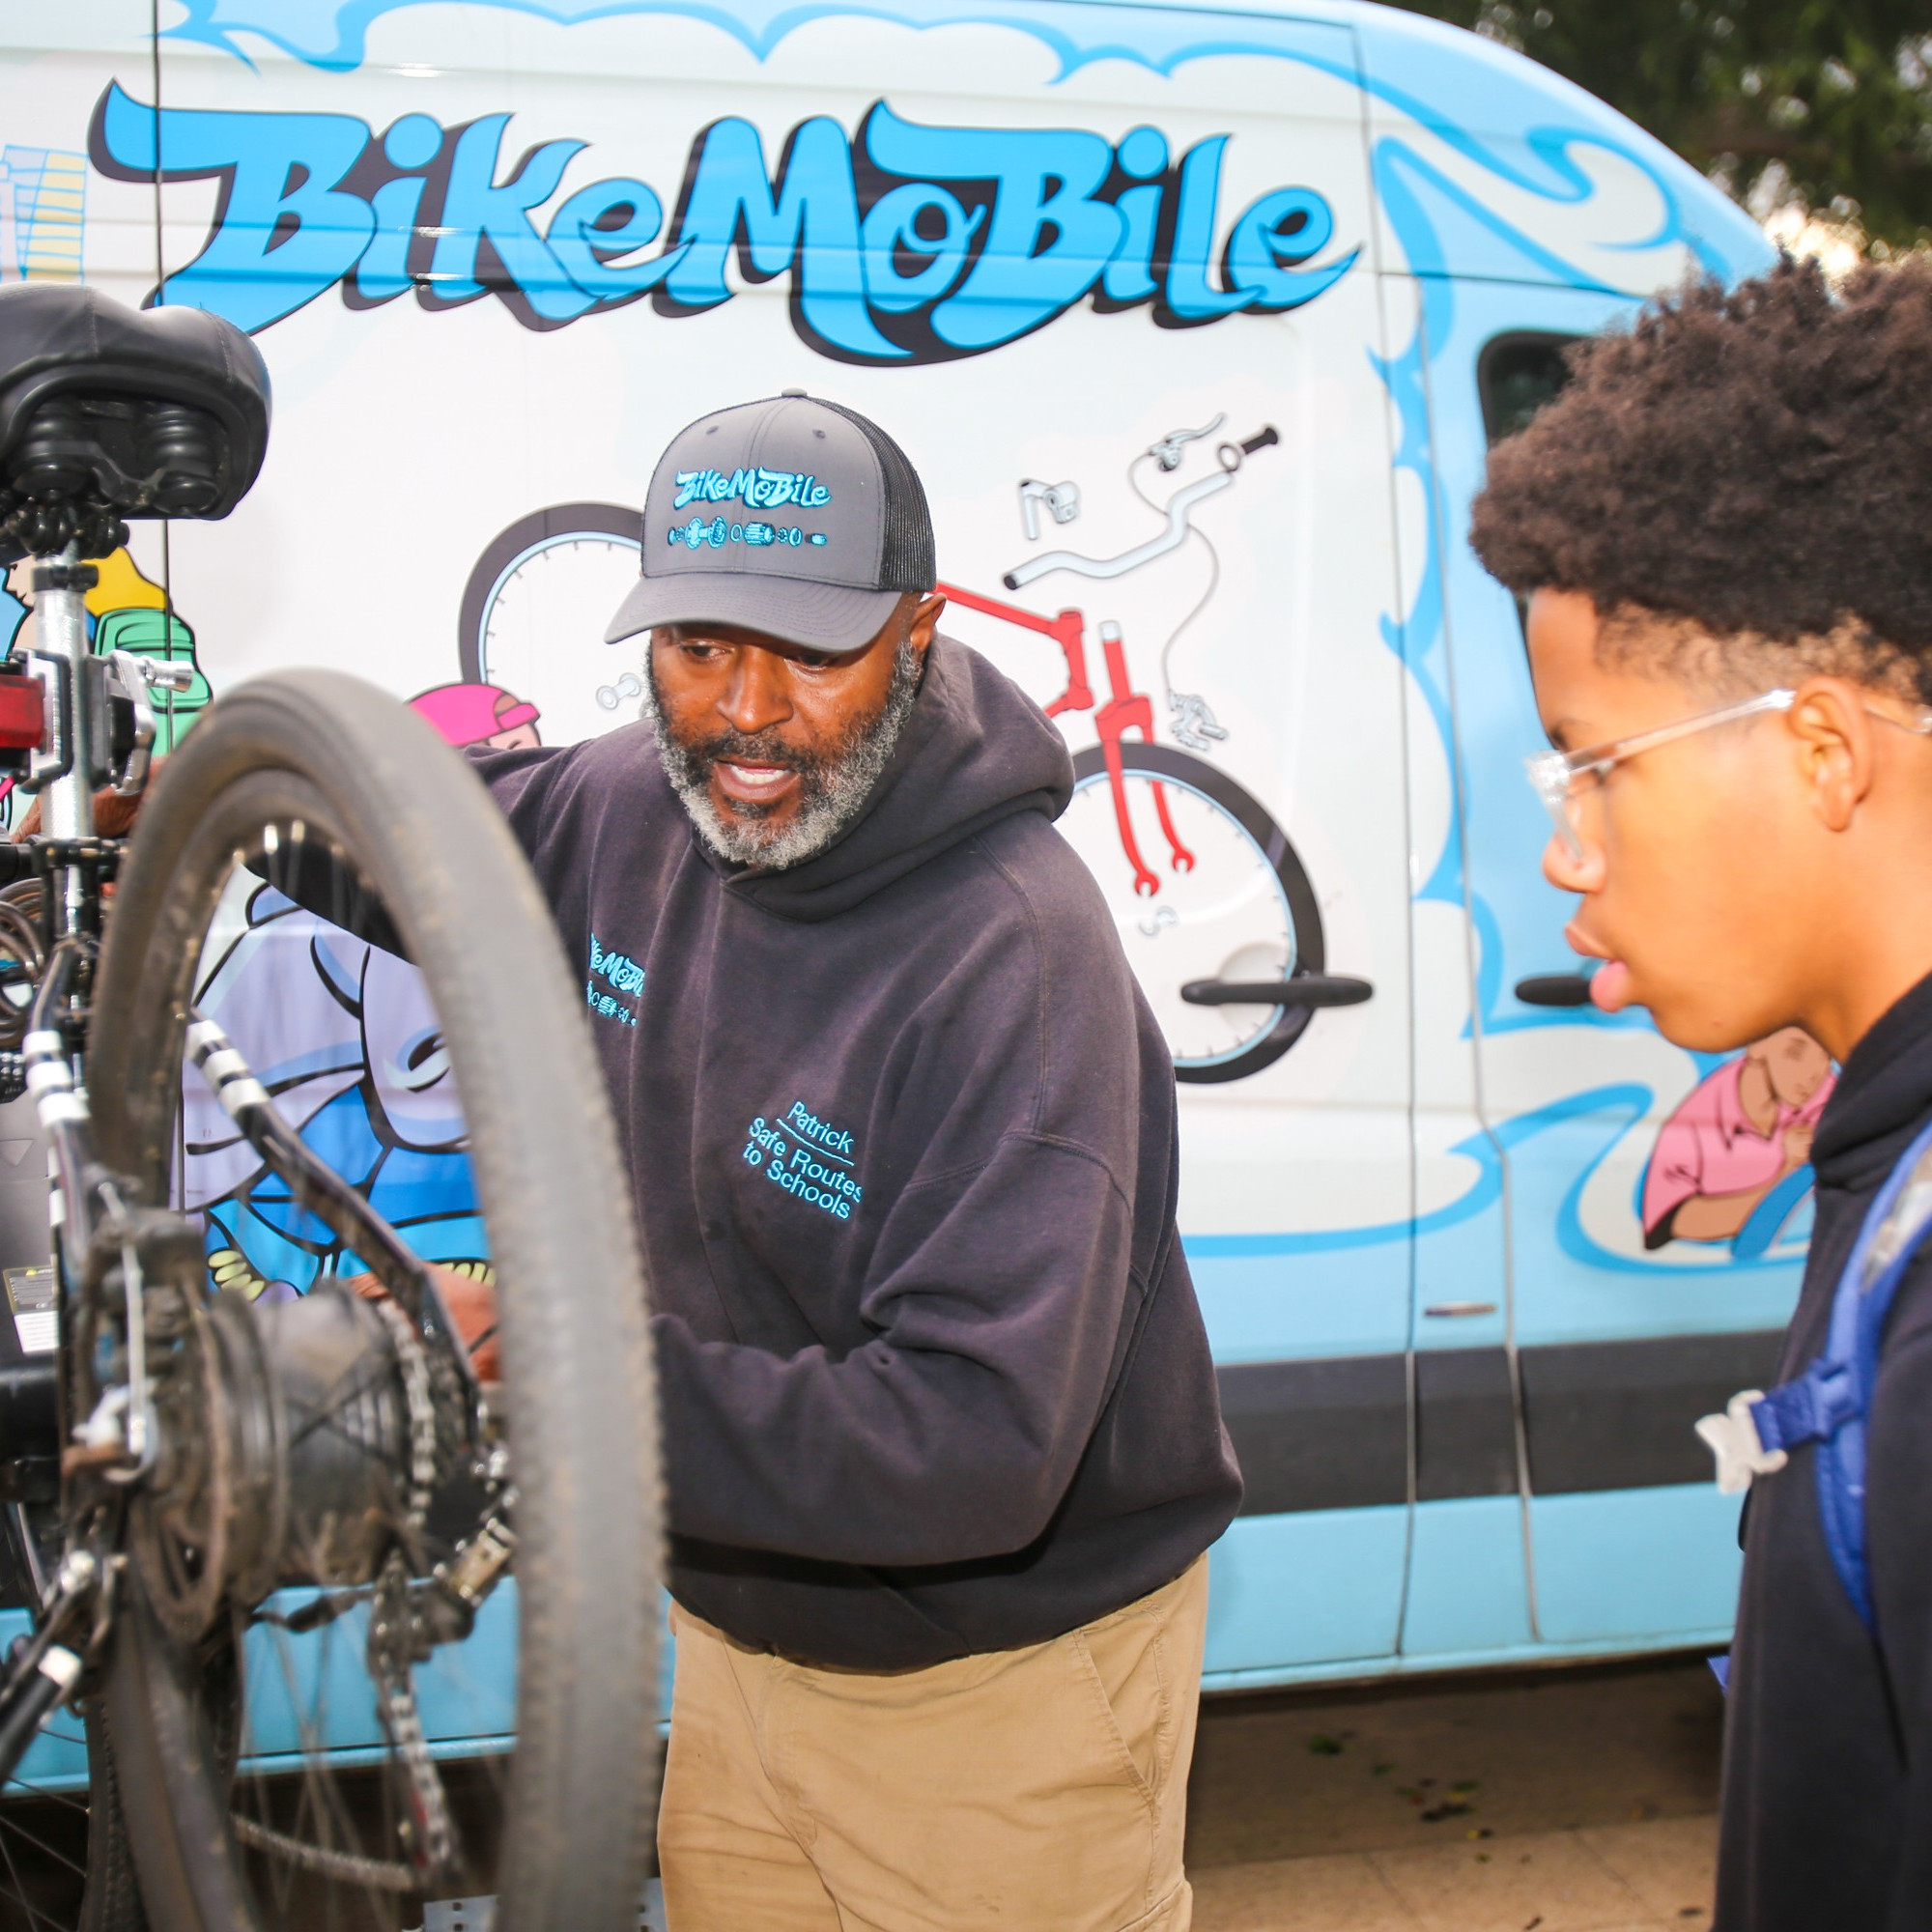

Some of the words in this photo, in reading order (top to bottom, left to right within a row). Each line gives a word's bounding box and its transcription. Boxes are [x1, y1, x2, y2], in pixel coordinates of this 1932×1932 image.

[749, 1117, 787, 1156] Safe
[789, 1149, 863, 1204] Routes
[786, 1100, 854, 1153] Patrick
[742, 1140, 762, 1166] to
[766, 1159, 851, 1219] Schools
